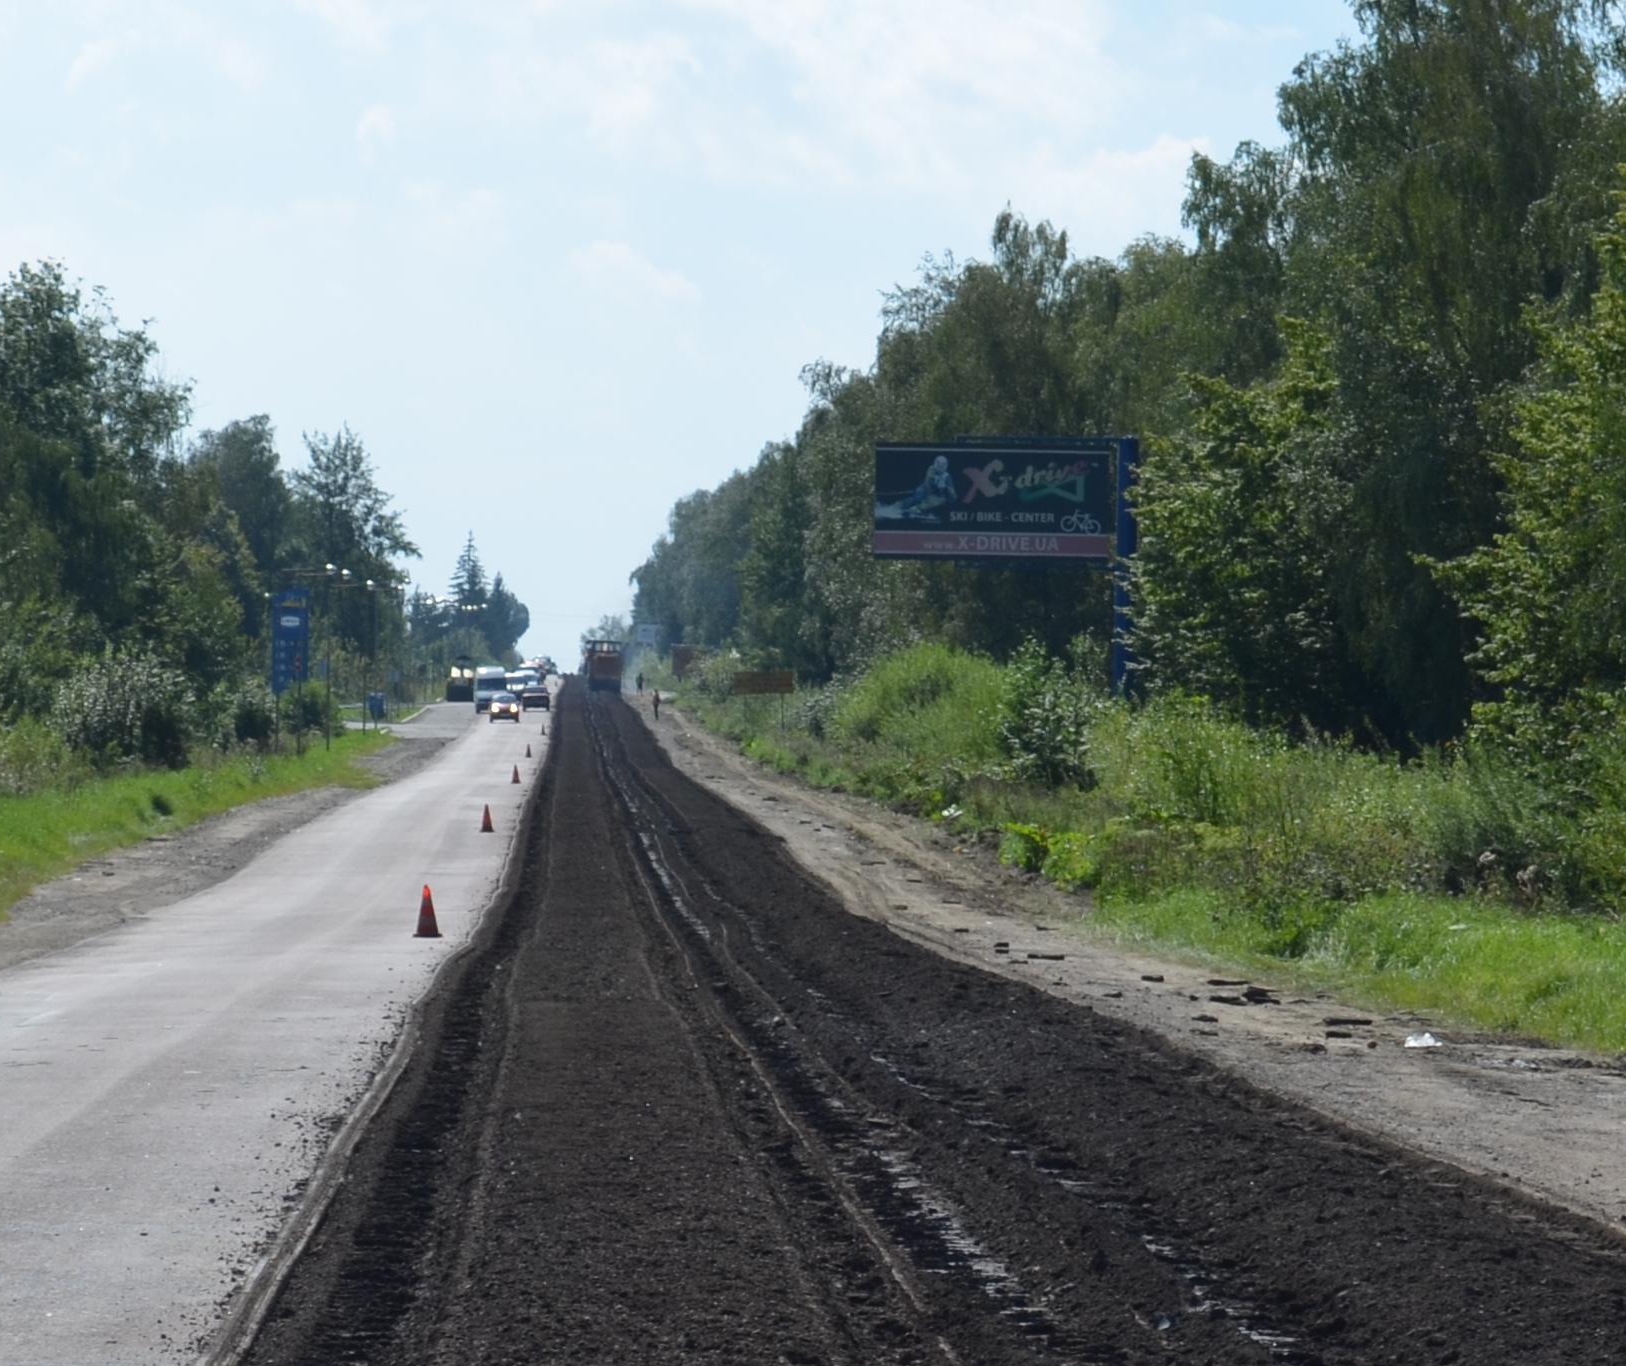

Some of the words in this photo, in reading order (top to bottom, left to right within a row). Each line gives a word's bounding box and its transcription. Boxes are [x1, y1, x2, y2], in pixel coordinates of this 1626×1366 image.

[950, 511, 968, 522] SKI
[976, 511, 1003, 522] BIKE
[1011, 511, 1055, 523] CENTER
